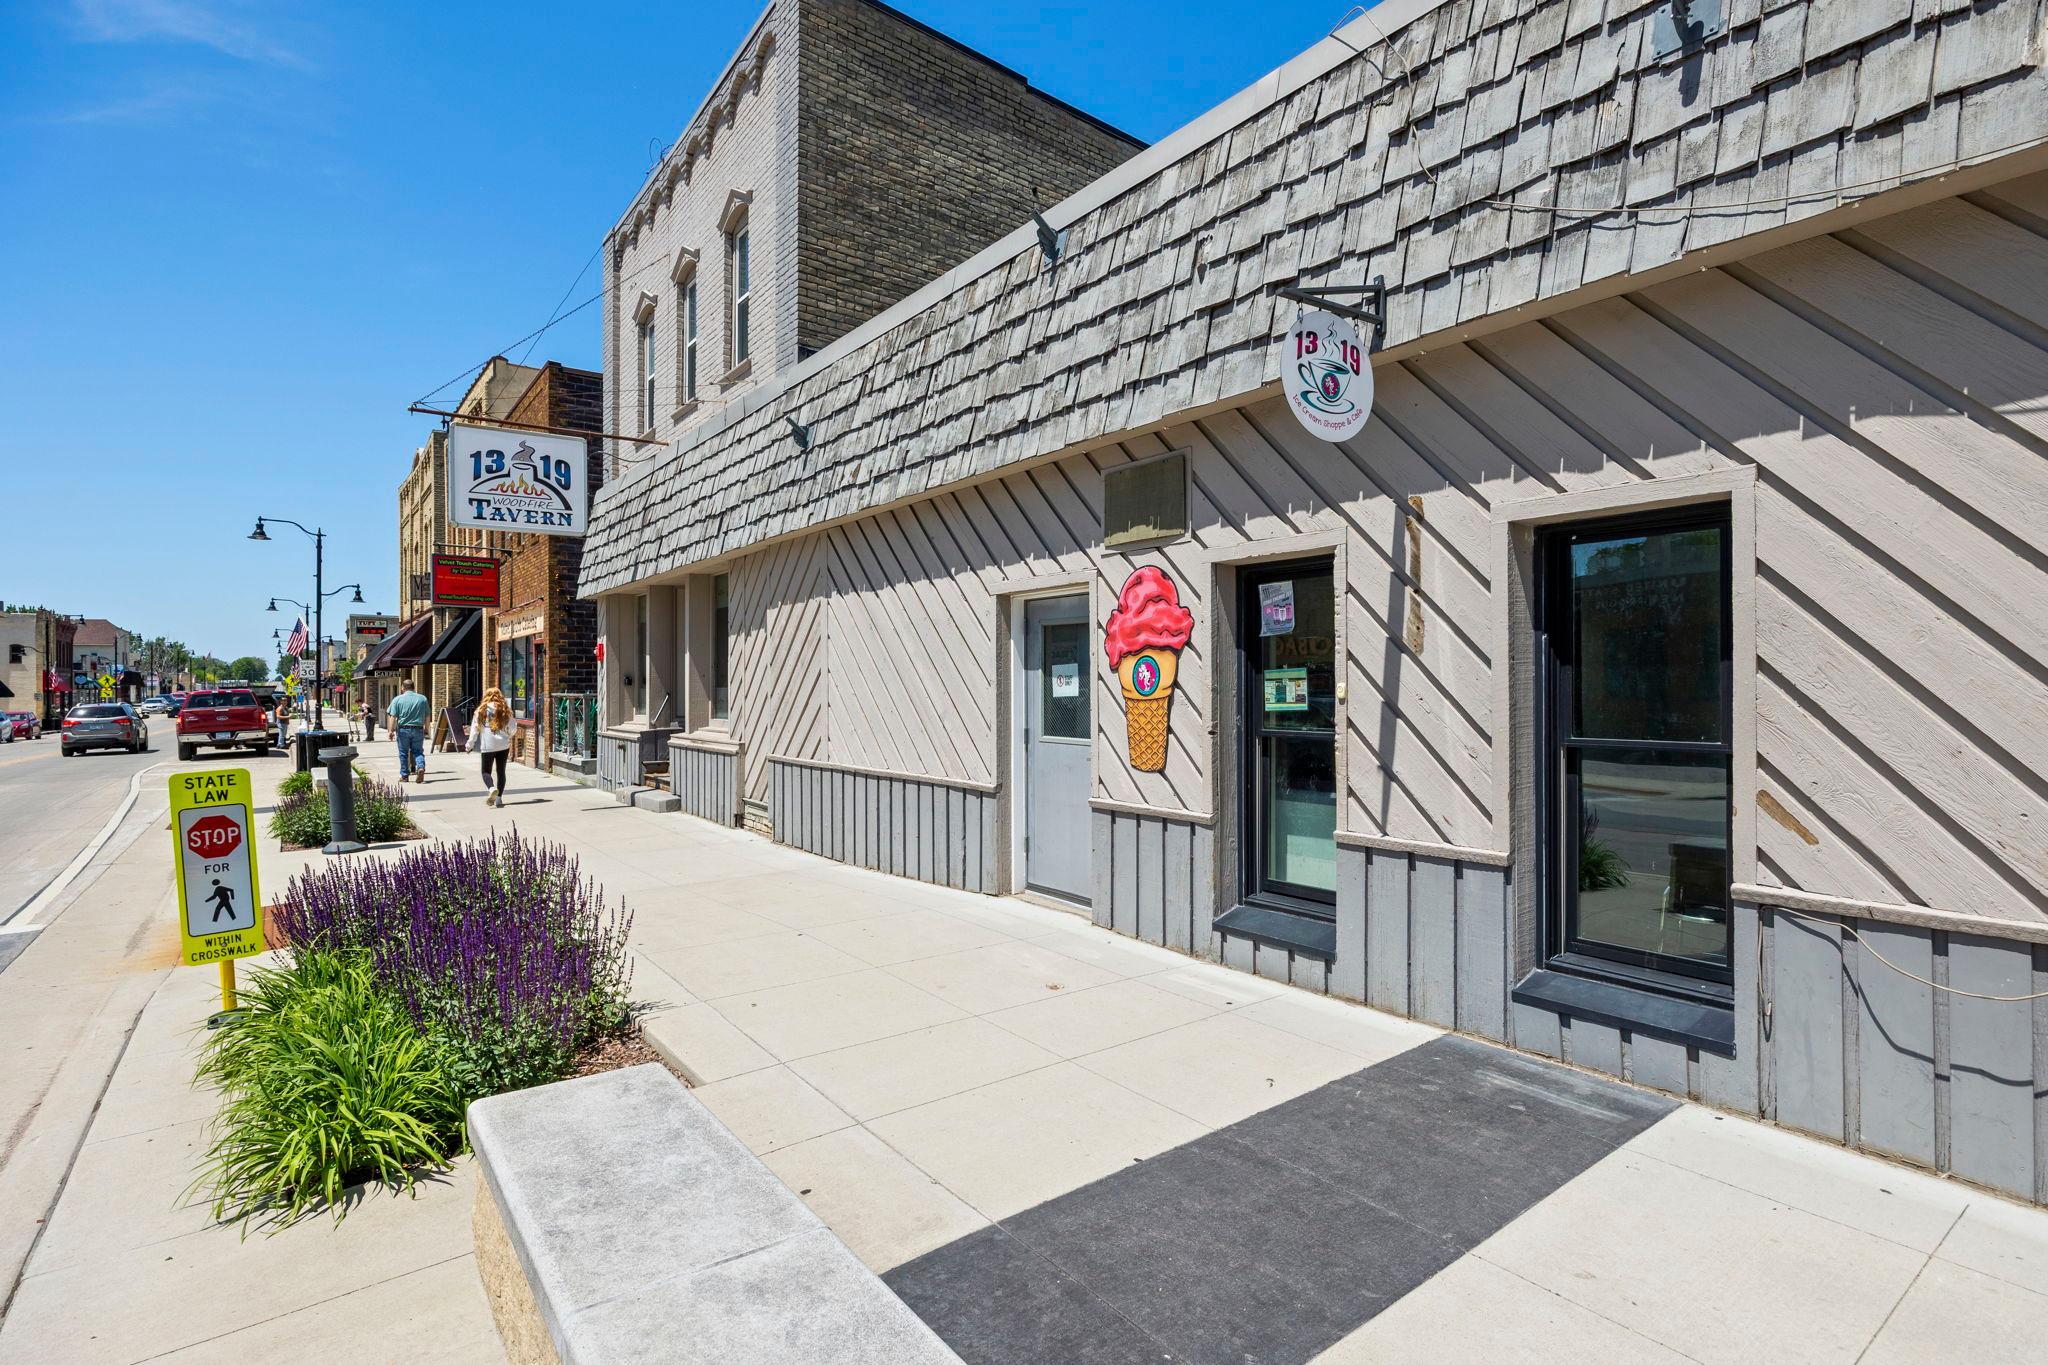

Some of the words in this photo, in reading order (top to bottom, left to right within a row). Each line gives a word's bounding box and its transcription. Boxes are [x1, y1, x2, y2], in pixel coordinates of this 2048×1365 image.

[1295, 330, 1319, 360] 13
[1340, 339, 1361, 377] 19
[1292, 394, 1302, 408] Ice
[1302, 406, 1322, 425] Cream
[1346, 417, 1352, 425] &
[469, 449, 506, 481] 13
[539, 454, 572, 491] 19
[492, 496, 553, 510] WOODFIRE
[468, 498, 573, 527] TAVERN
[472, 561, 495, 569] Catering
[301, 668, 315, 677] 30
[184, 774, 237, 790] STATE
[193, 789, 229, 804] LAW
[189, 826, 239, 848] STOP
[204, 862, 230, 875] FOR
[204, 933, 242, 948] WITHIN
[191, 942, 257, 962] CROSSWALK
